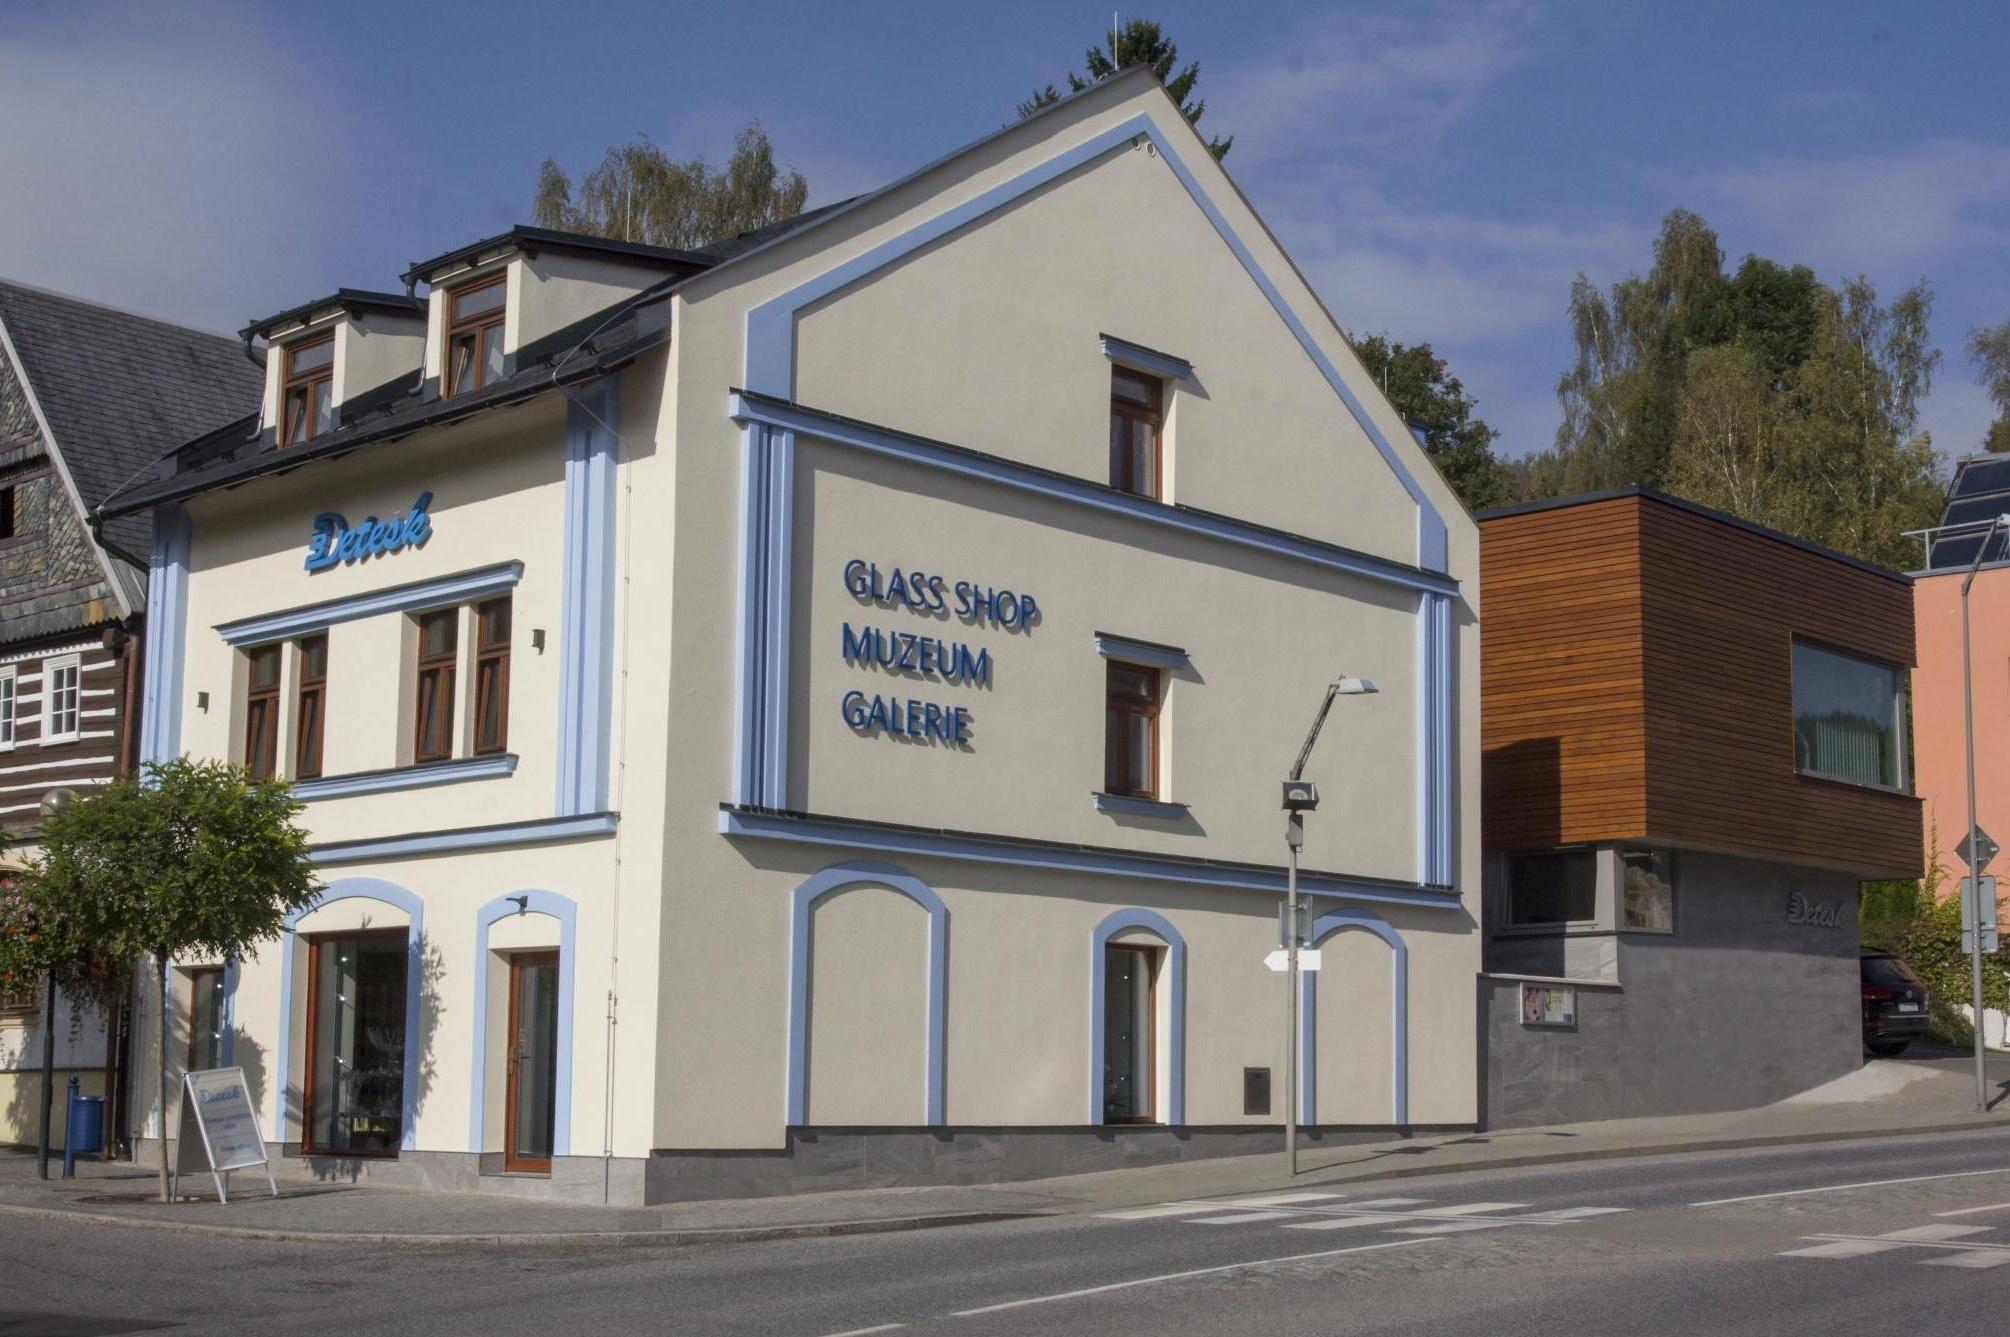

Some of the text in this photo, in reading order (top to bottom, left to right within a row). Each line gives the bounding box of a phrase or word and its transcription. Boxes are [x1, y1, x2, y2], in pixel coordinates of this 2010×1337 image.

[304, 491, 433, 571] Detesk
[843, 559, 1036, 629] GLASS SHOP
[841, 622, 987, 682] MUZEUM
[841, 690, 968, 743] GALERIE
